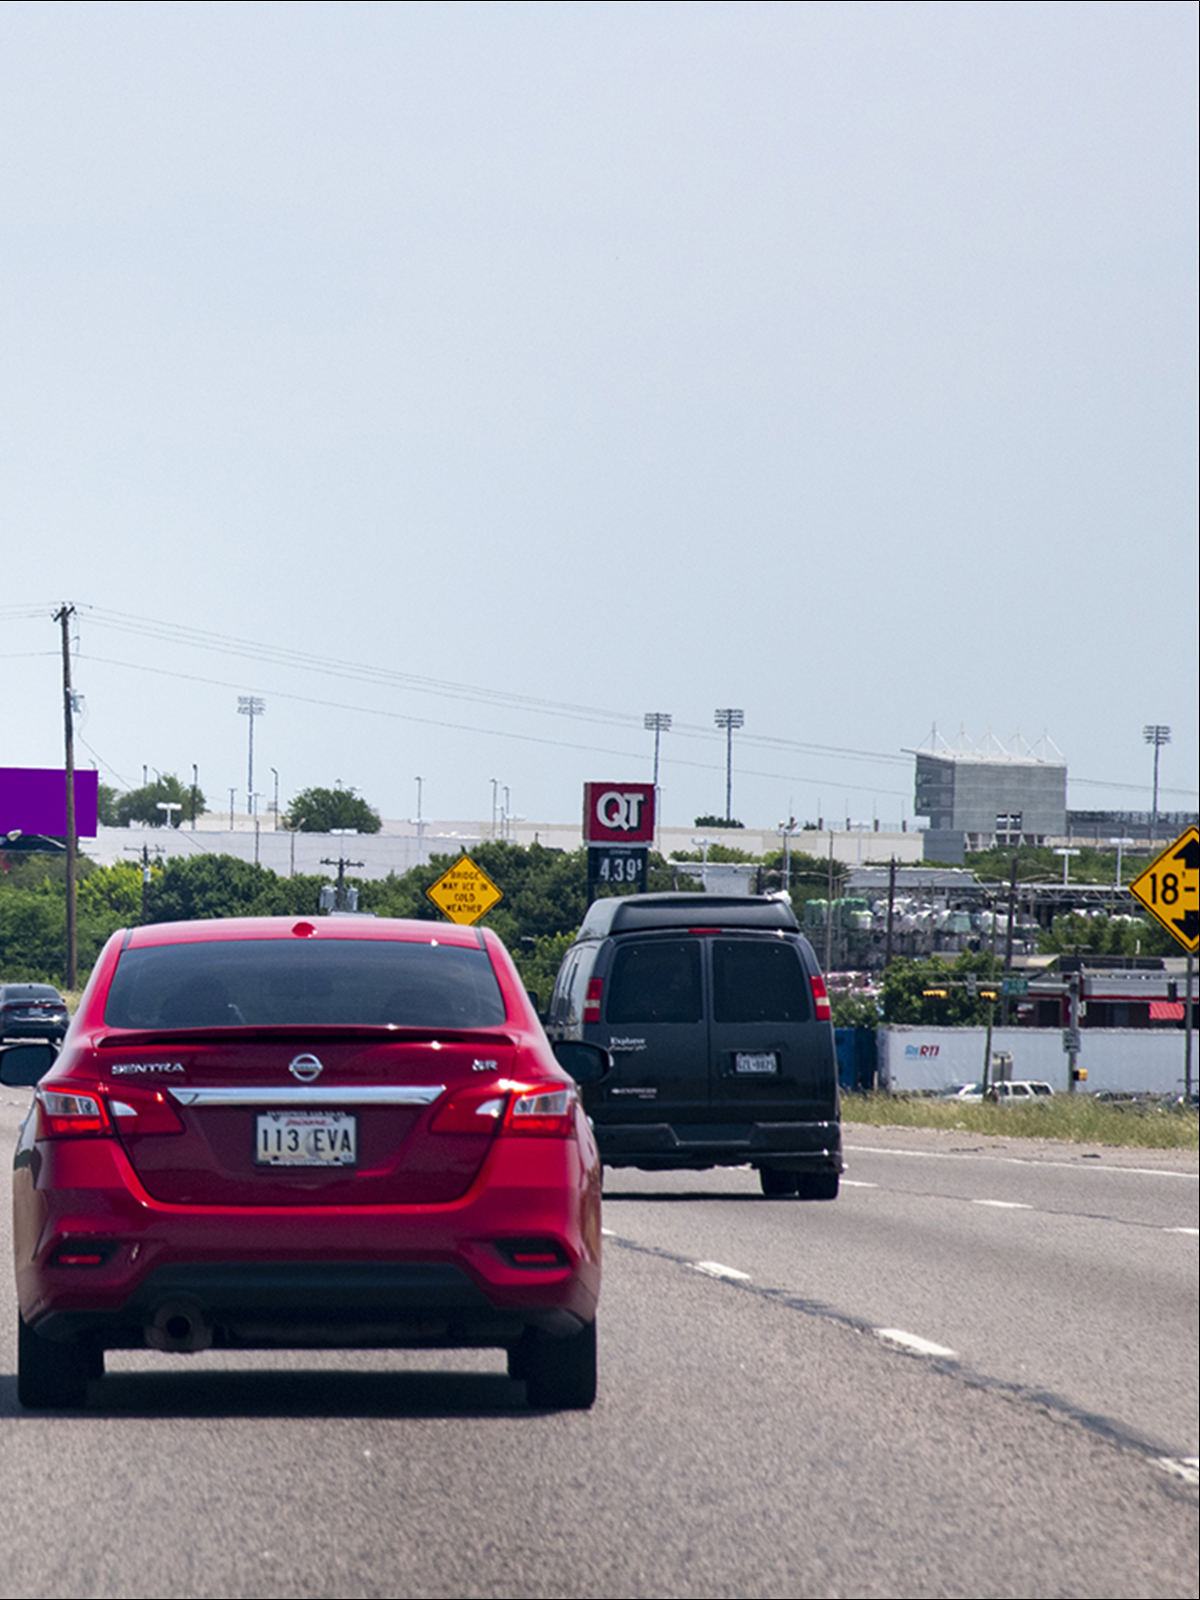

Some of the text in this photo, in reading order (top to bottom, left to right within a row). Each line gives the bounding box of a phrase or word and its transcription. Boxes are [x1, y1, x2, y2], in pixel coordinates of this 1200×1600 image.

[596, 791, 645, 831] QT
[451, 871, 480, 881] BRIDGE
[442, 882, 458, 891] MAY
[462, 882, 475, 891] ICE
[454, 893, 475, 903] COLD
[446, 903, 482, 913] WEATHER
[111, 1063, 185, 1075] SENTRA
[263, 1129, 352, 1152] 113 EVA
